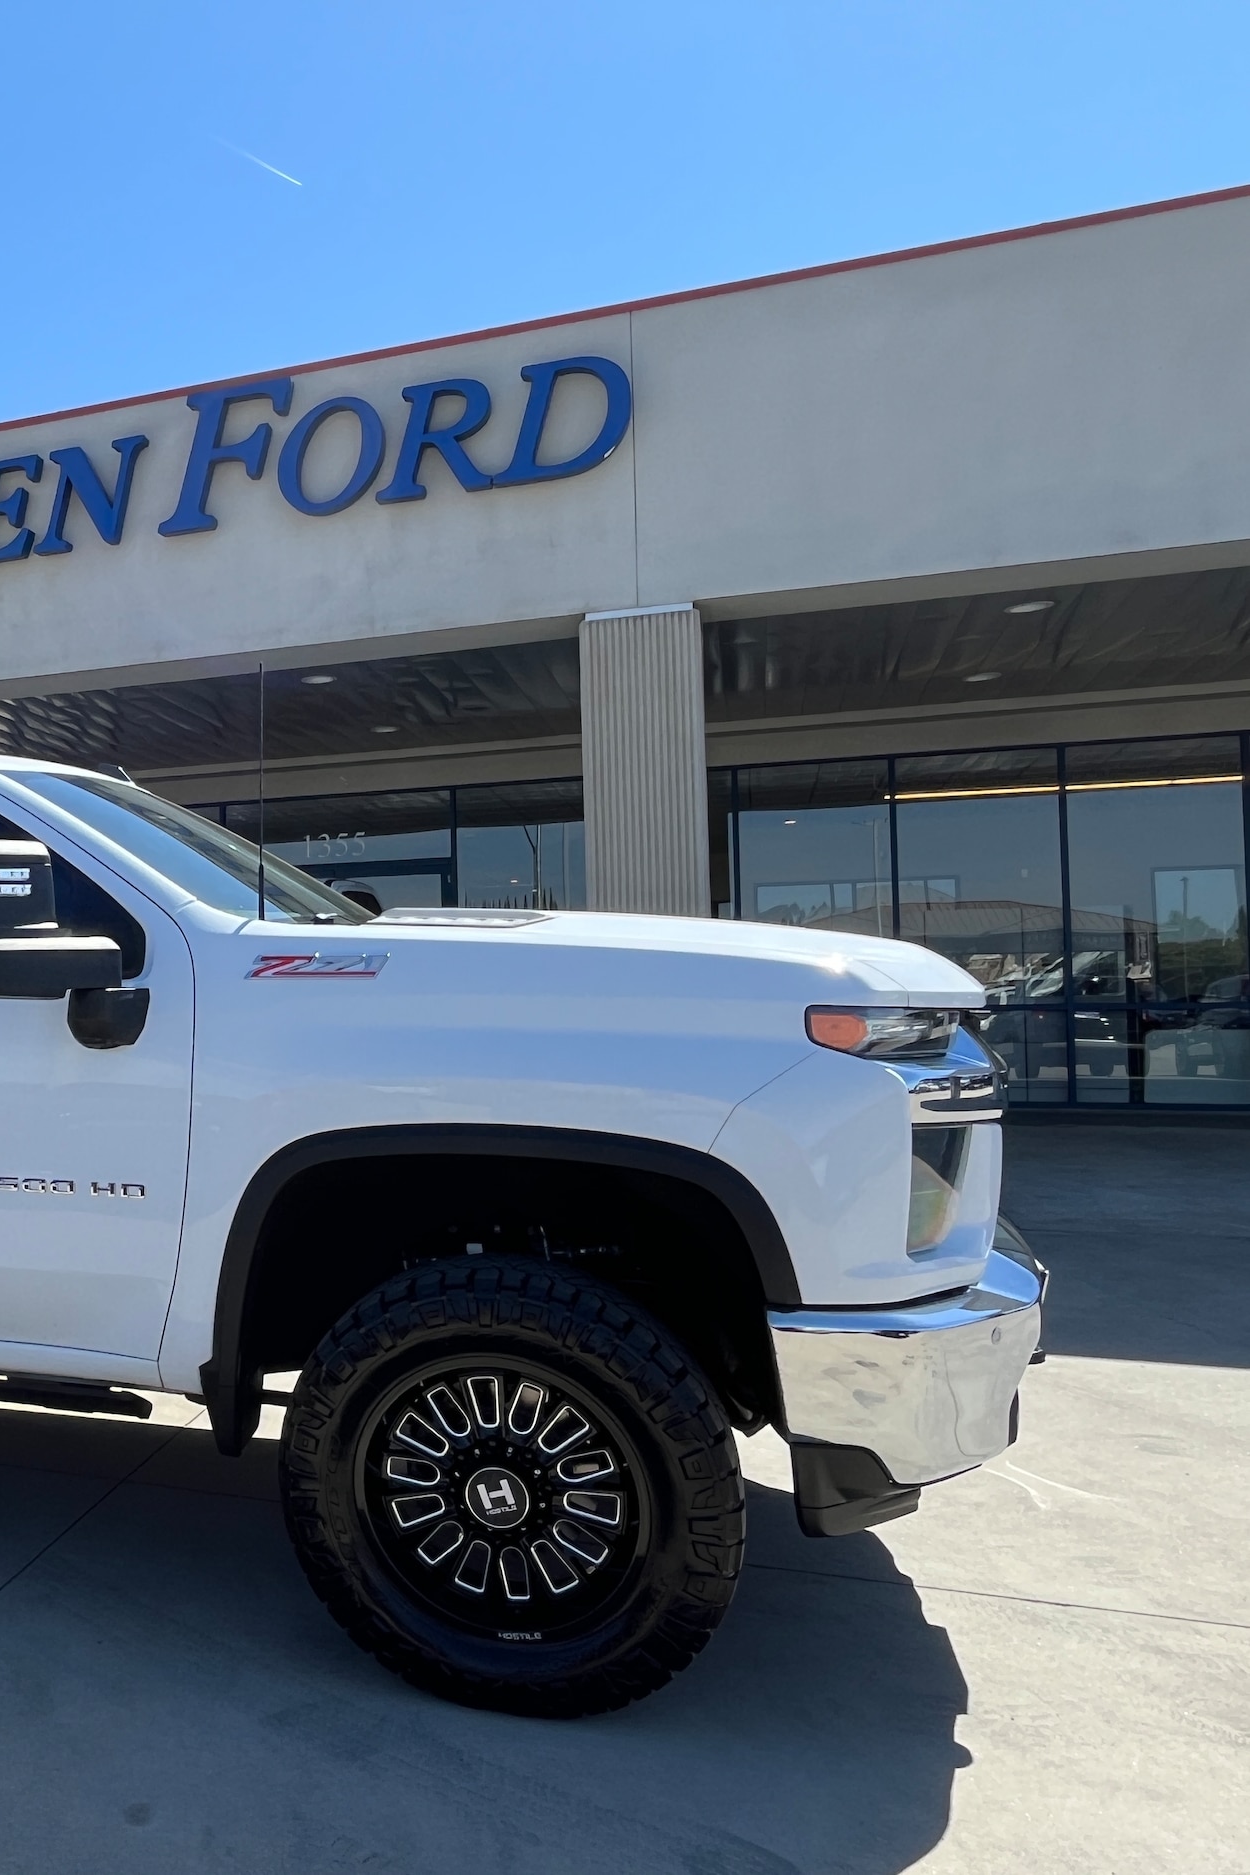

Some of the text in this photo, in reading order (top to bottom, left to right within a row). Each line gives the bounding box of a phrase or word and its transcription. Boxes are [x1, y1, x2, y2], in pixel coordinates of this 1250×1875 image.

[158, 356, 632, 537] FORD
[304, 831, 366, 858] 1355
[90, 1182, 146, 1199] HD
[477, 1479, 516, 1510] H
